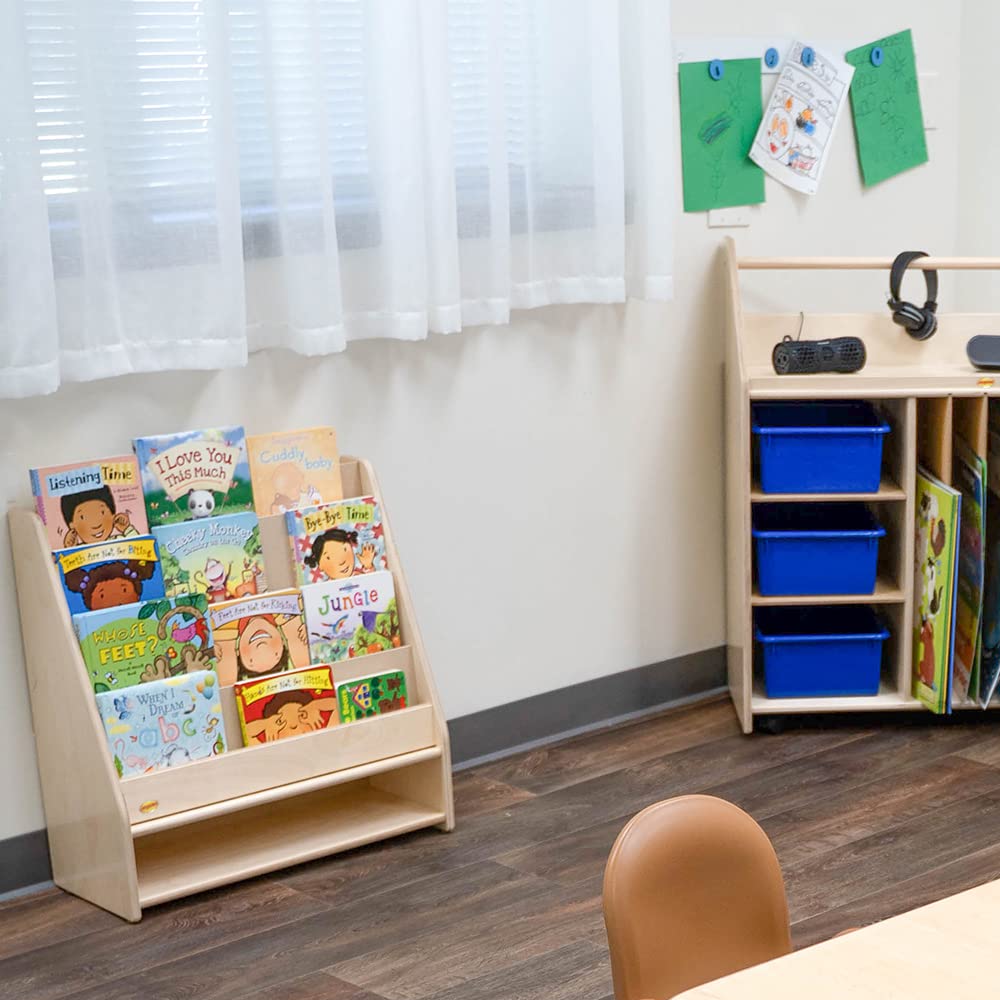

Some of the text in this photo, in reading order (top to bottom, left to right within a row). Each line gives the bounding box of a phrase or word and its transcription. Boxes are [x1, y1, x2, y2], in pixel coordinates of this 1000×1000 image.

[155, 447, 233, 475] I Love You
[259, 447, 305, 465] Cuddly
[304, 456, 334, 471] baby
[48, 466, 133, 491] Listening Time
[165, 467, 227, 488] This Much
[305, 506, 369, 532] Bye-Bye Time
[209, 523, 254, 540] Monkey
[92, 621, 146, 646] WHOSE
[98, 634, 160, 666] FEET?
[135, 688, 169, 705] WHEN
[149, 700, 184, 717] DREAM
